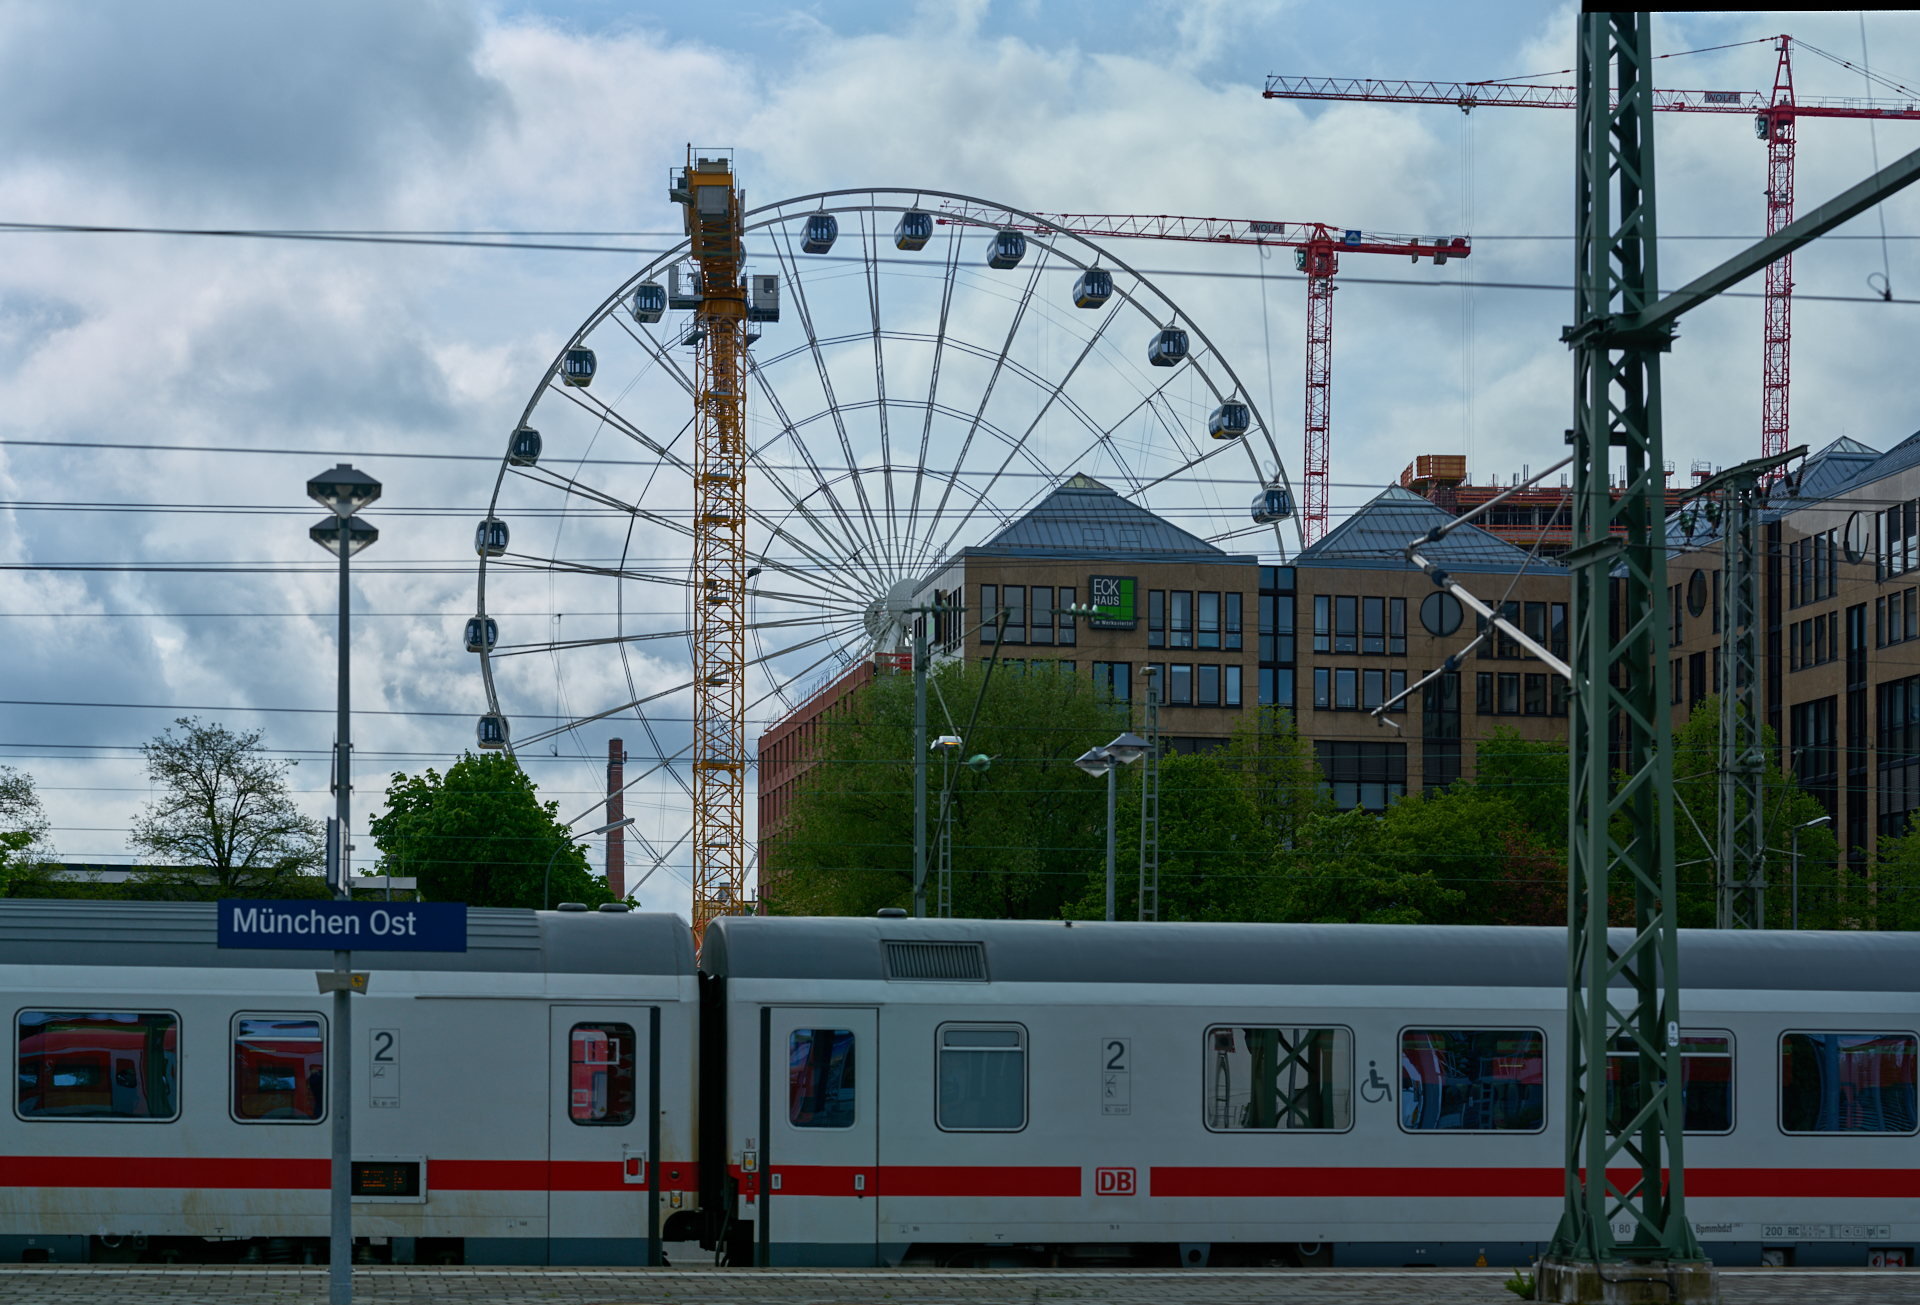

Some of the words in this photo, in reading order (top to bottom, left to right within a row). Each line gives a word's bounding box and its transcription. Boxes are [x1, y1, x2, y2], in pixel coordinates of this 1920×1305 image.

[1707, 94, 1740, 102] WOLFF
[1253, 224, 1284, 232] WOLFF
[1093, 578, 1120, 595] ECK
[1093, 596, 1120, 606] HAUS
[233, 907, 360, 935] München
[369, 909, 416, 936] Ost
[374, 1031, 394, 1062] 2
[1106, 1041, 1125, 1070] 2
[1101, 1171, 1132, 1191] DB
[1618, 1224, 1631, 1234] 80
[1765, 1226, 1783, 1236] 200
[1787, 1226, 1800, 1236] RIC
